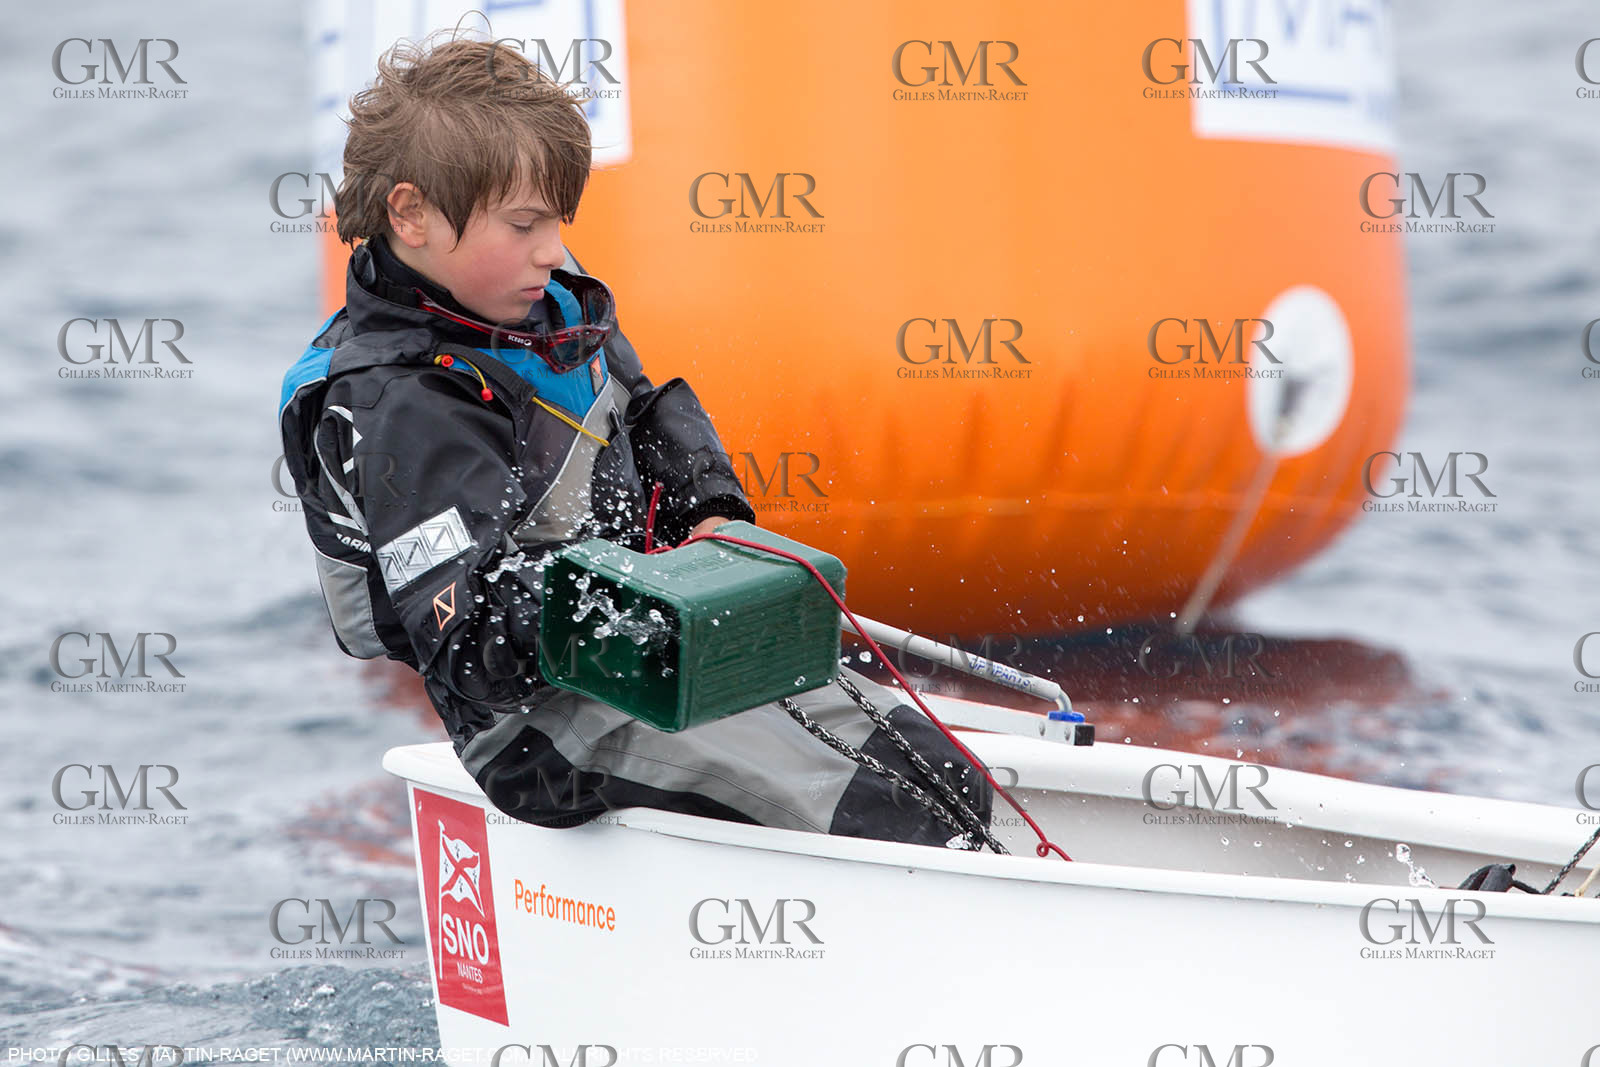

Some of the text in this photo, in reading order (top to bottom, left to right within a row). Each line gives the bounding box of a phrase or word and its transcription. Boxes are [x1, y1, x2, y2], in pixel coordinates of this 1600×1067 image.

[513, 879, 616, 931] Performance
[443, 913, 489, 966] SNO
[457, 961, 483, 984] NANTES
